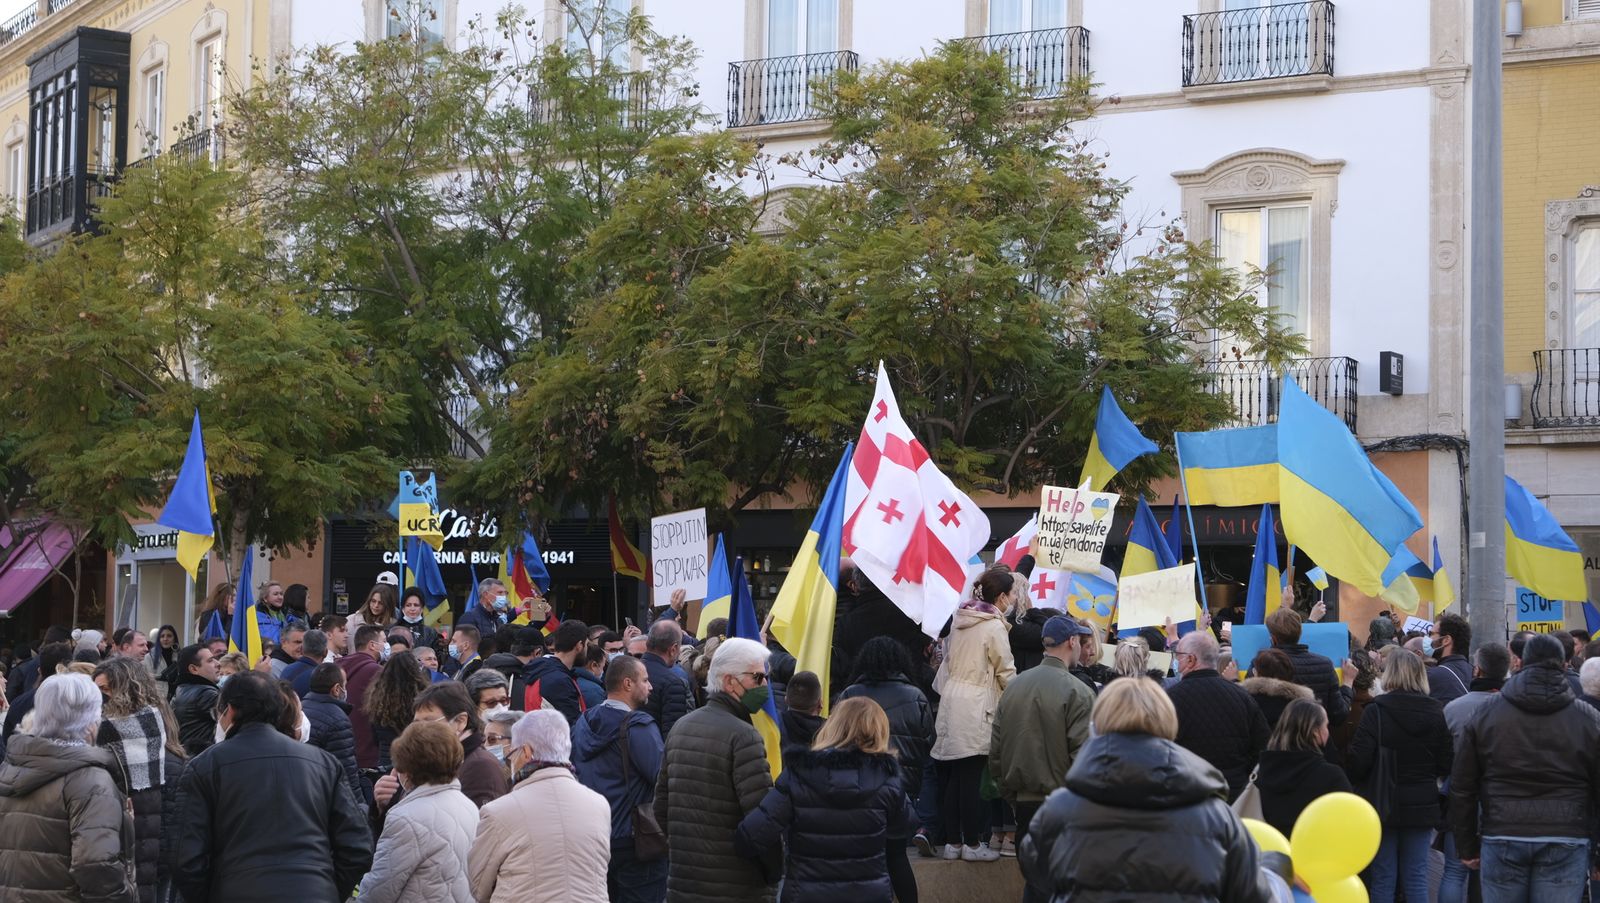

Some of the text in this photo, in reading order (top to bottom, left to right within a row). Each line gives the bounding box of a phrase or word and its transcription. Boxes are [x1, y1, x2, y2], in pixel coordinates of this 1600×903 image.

[1047, 489, 1085, 522] Help
[382, 551, 466, 564] CALRNIA
[541, 551, 575, 564] 1941
